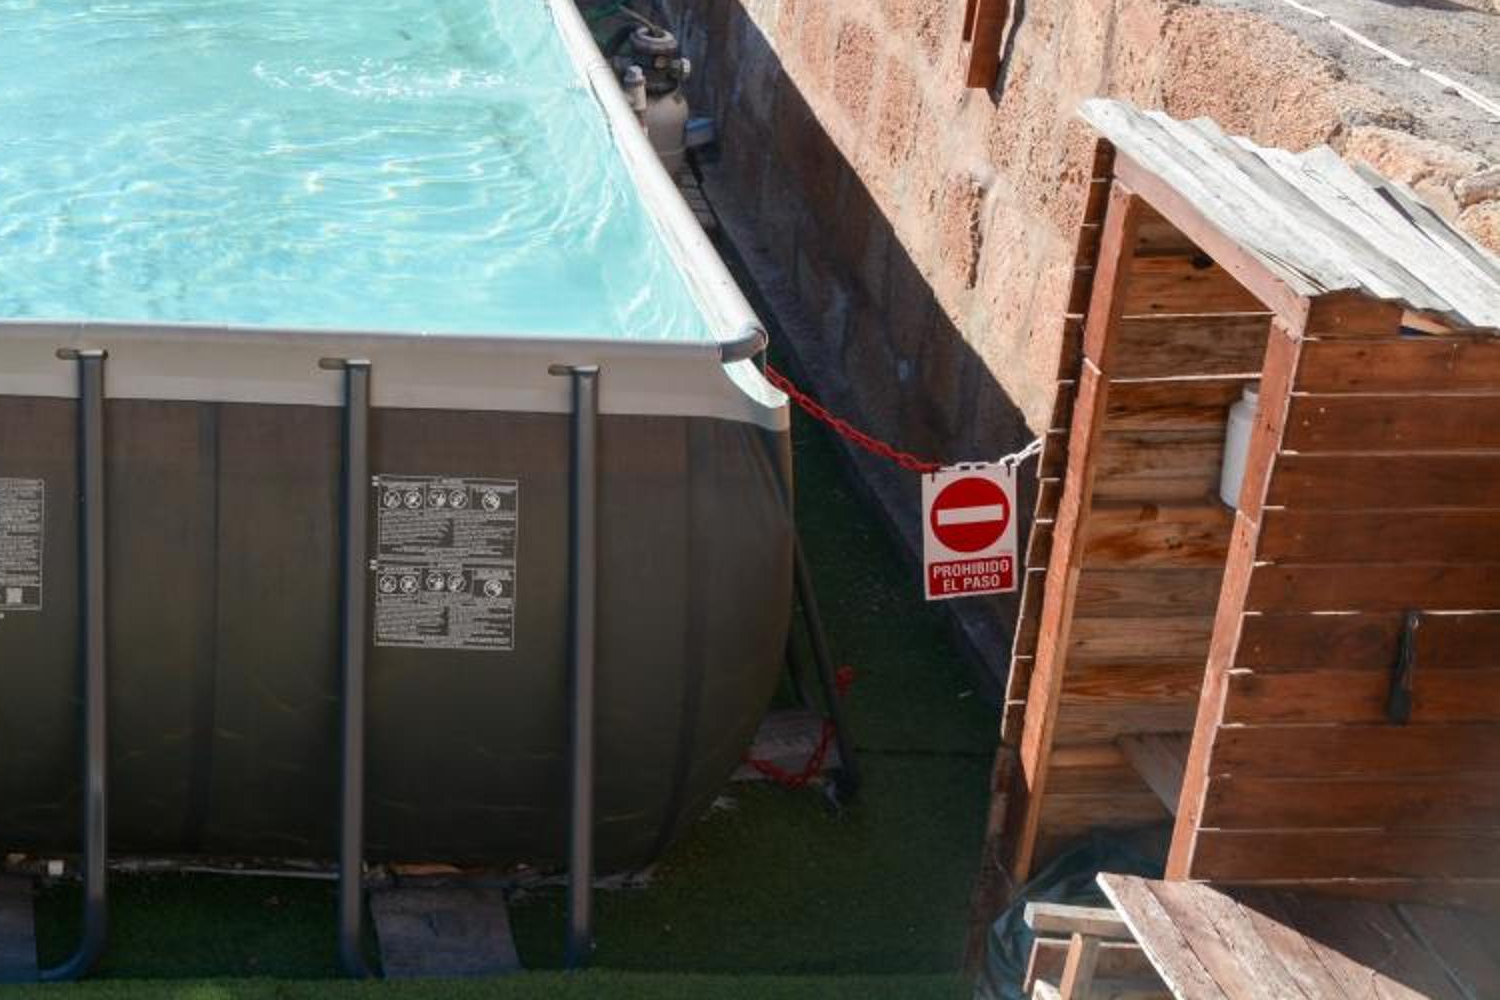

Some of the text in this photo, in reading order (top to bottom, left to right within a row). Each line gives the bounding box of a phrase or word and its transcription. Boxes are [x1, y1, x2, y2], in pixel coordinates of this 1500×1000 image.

[932, 559, 1010, 579] PROHIBIDO
[943, 574, 1001, 592] EL PASO
